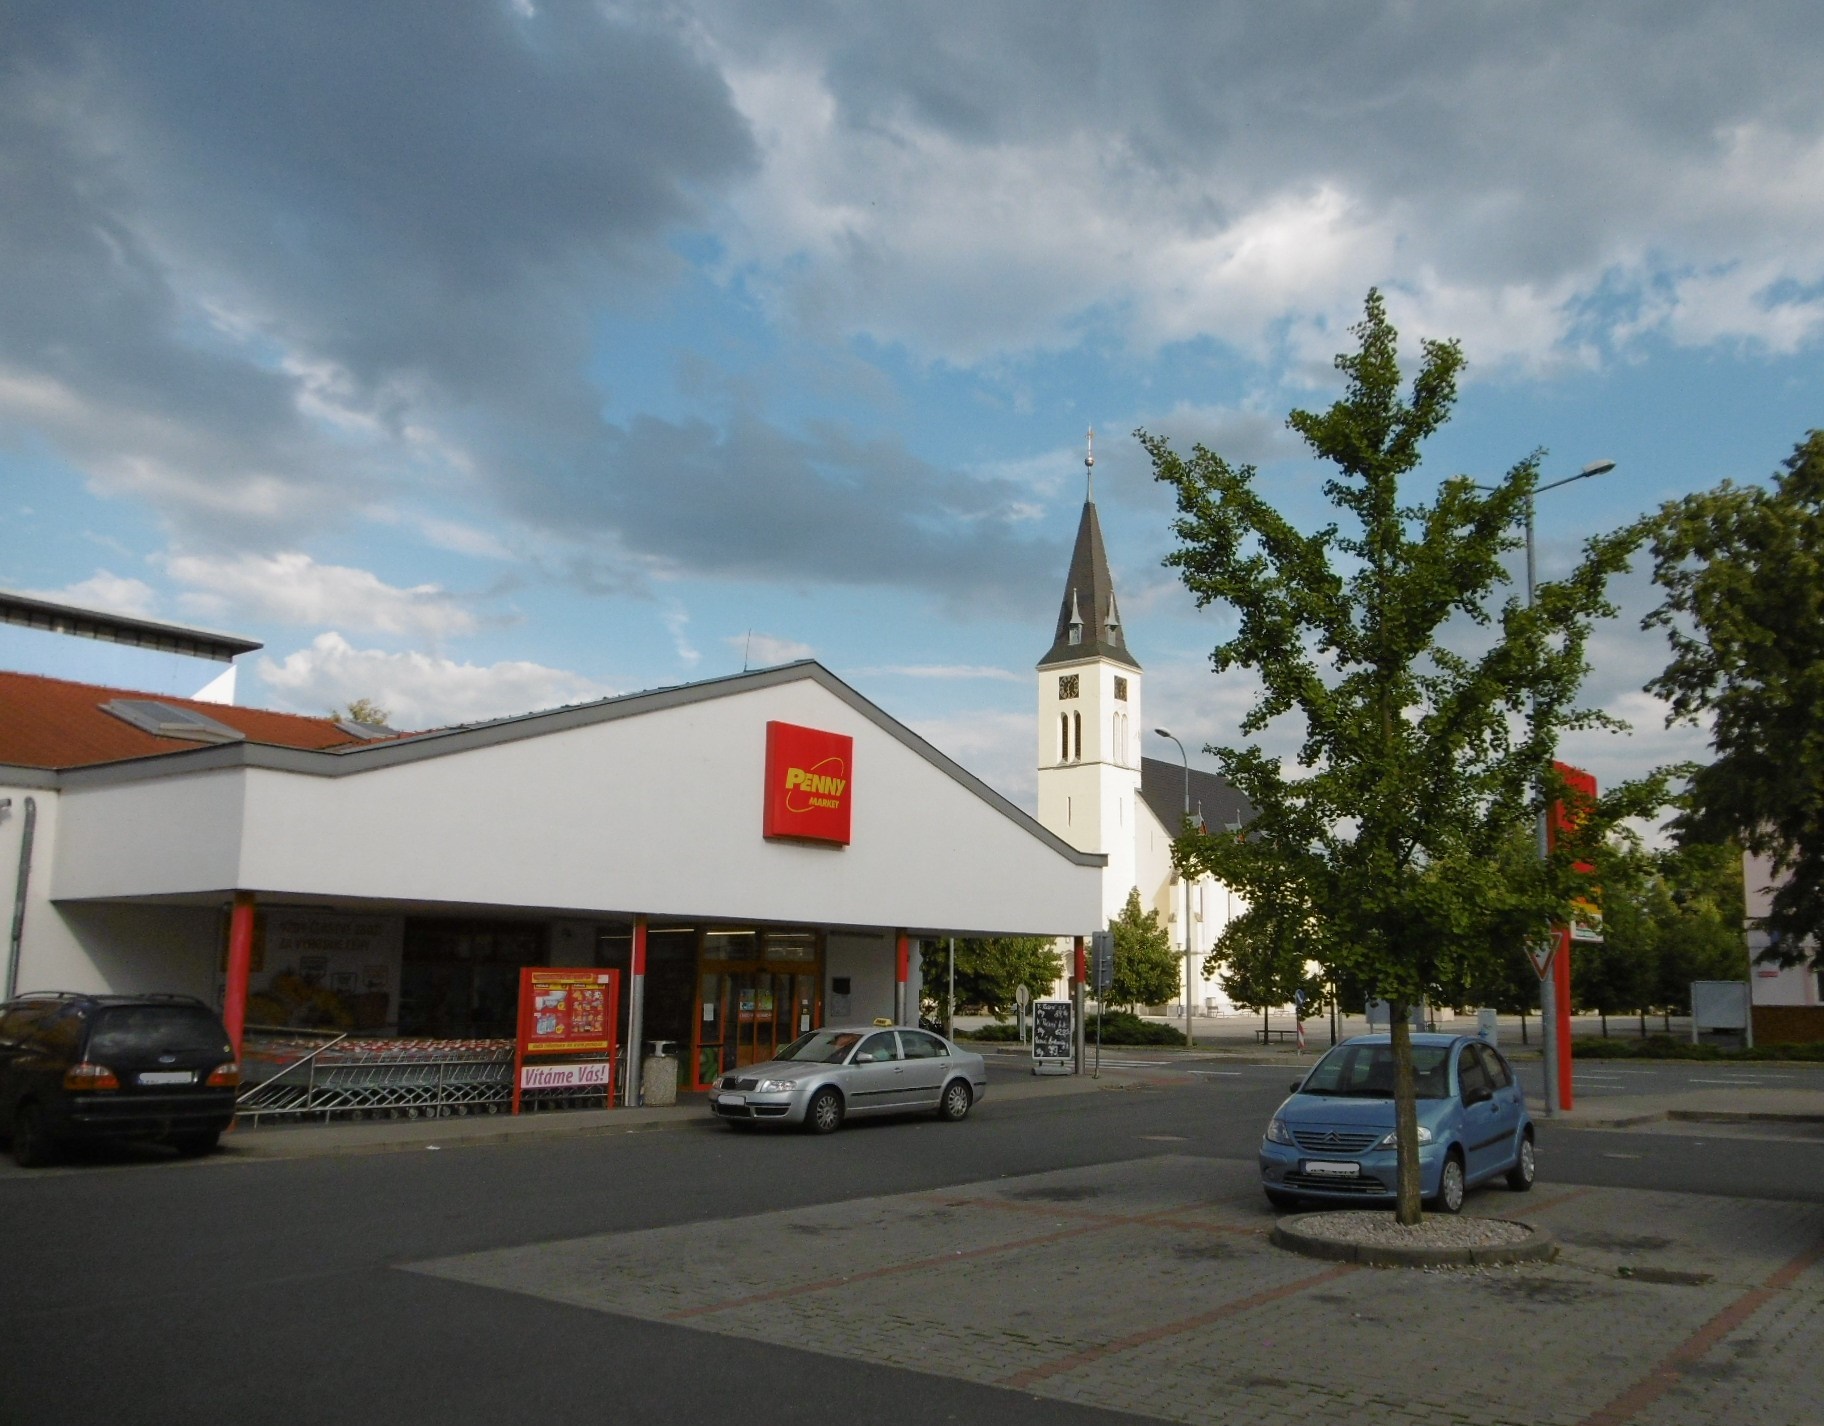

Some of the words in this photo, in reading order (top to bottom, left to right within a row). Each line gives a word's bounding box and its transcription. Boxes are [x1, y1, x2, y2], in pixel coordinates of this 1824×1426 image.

[786, 768, 846, 796] PENNY
[809, 797, 839, 808] MARKET
[525, 1067, 574, 1086] Vítáme
[578, 1064, 606, 1083] Vás!
